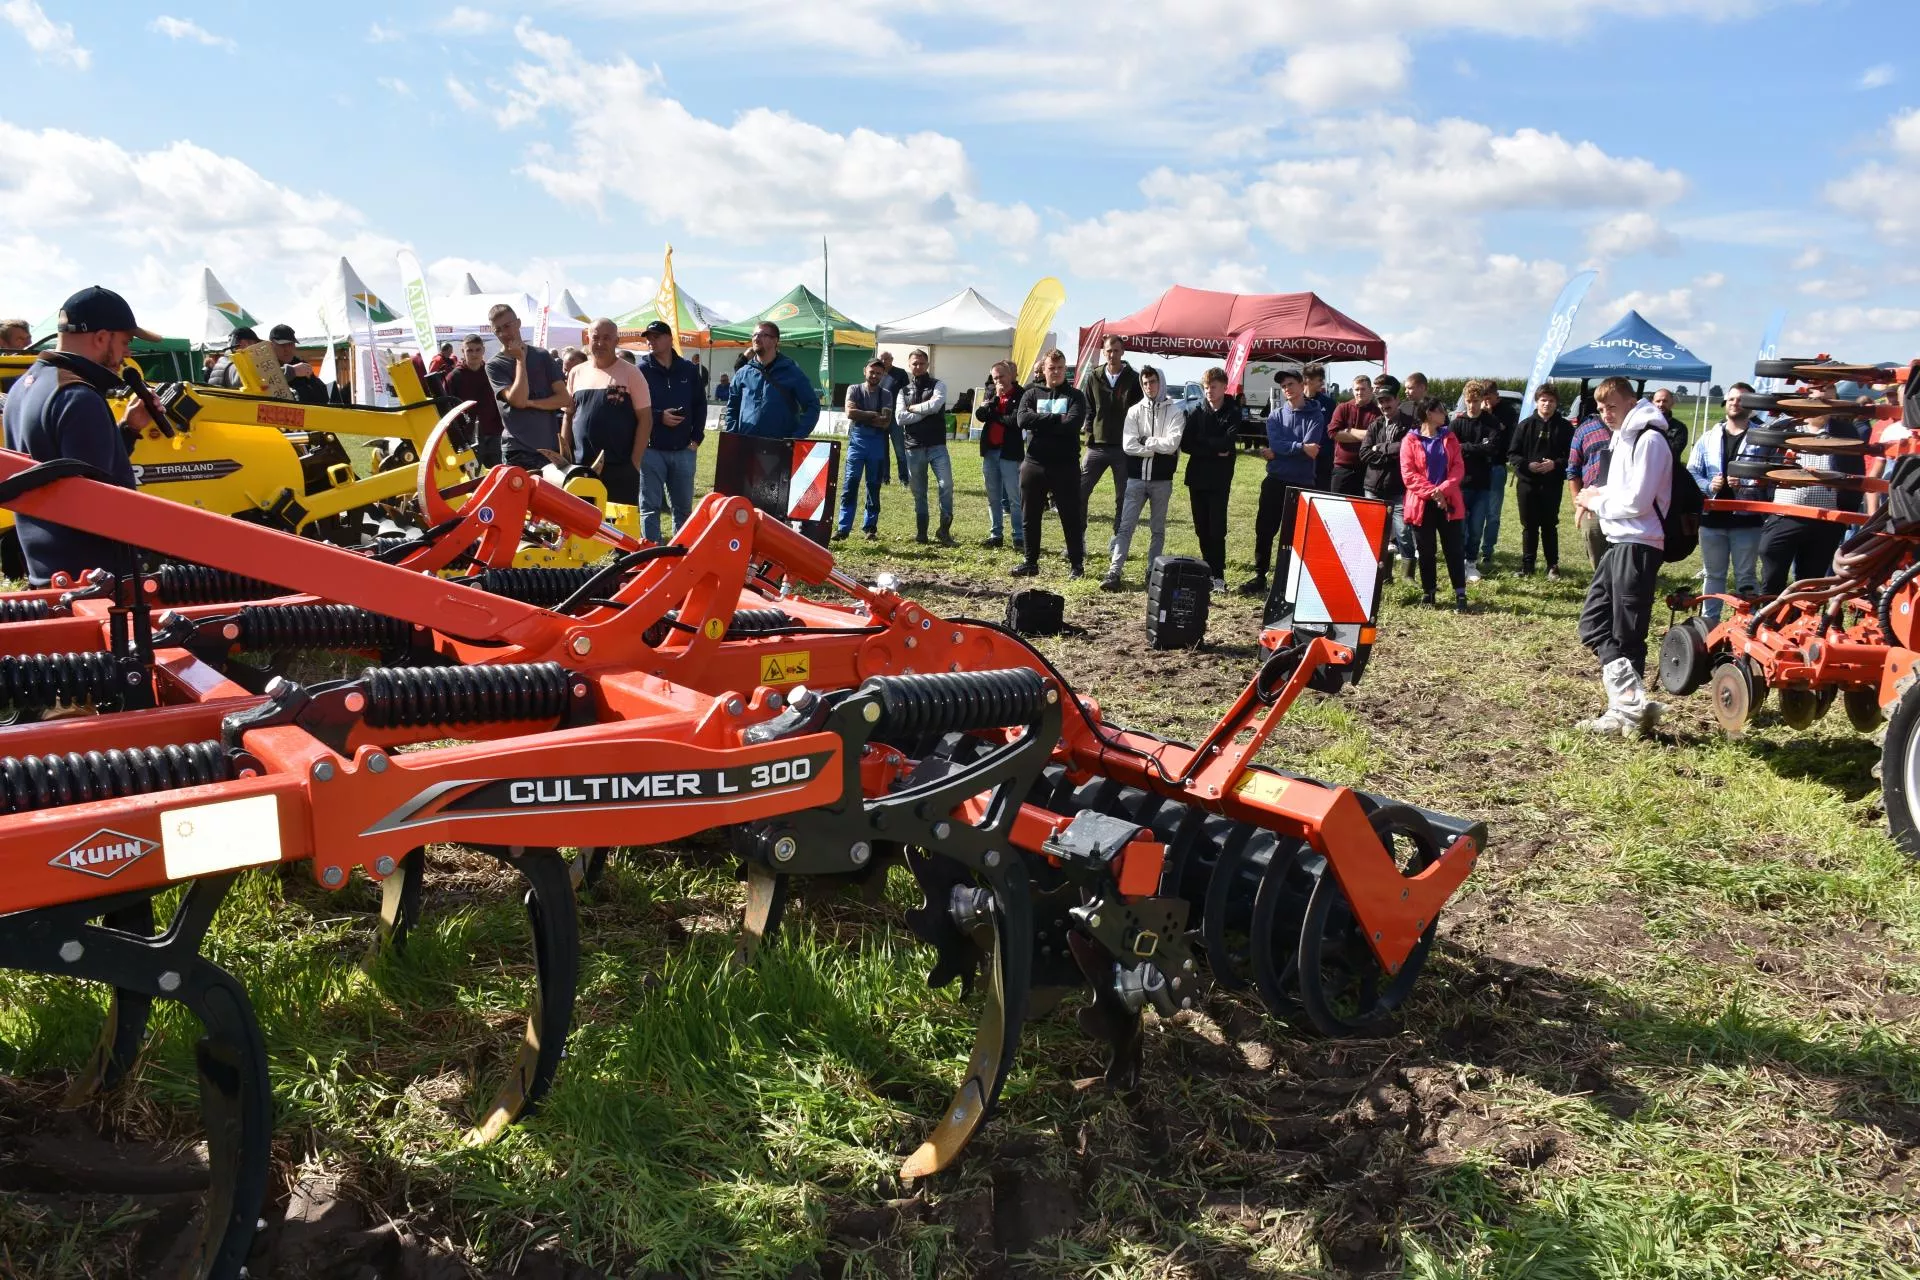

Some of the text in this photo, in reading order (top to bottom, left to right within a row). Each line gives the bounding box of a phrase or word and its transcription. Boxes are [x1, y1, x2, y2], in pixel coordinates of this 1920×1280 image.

[1132, 336, 1224, 349] INTERNETOWY
[1227, 338, 1367, 356] WW.TRAKTORY.COM
[155, 463, 214, 475] TERRALAND
[510, 758, 811, 804] CULTIMER L 300
[69, 841, 142, 867] KUHN
